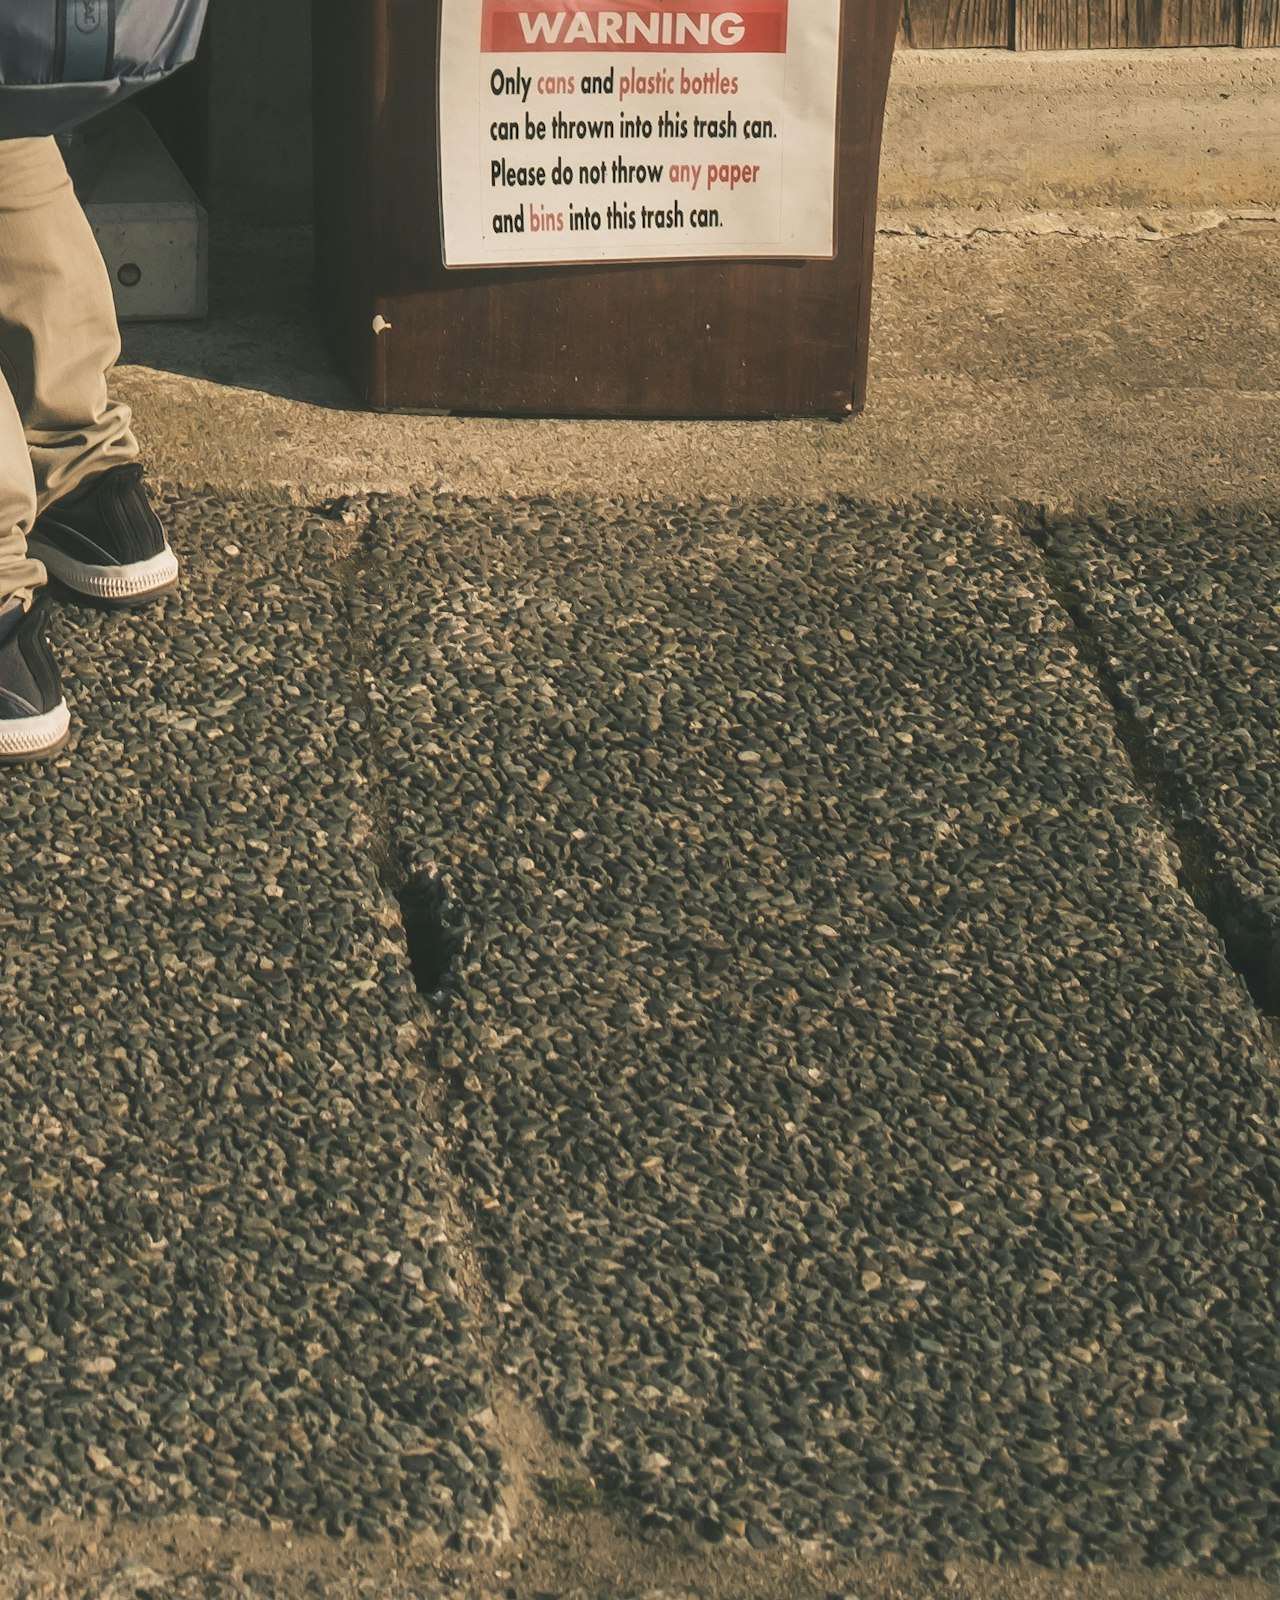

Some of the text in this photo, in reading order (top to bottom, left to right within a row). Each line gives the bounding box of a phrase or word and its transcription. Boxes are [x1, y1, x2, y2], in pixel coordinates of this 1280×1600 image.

[518, 11, 746, 45] WARNING
[490, 67, 738, 101] Only cans and plastic bottles
[490, 111, 777, 141] can be thrown into this trash can.
[491, 155, 760, 191] Please do not throw any paper
[492, 201, 723, 234] and bins into this trash can.
